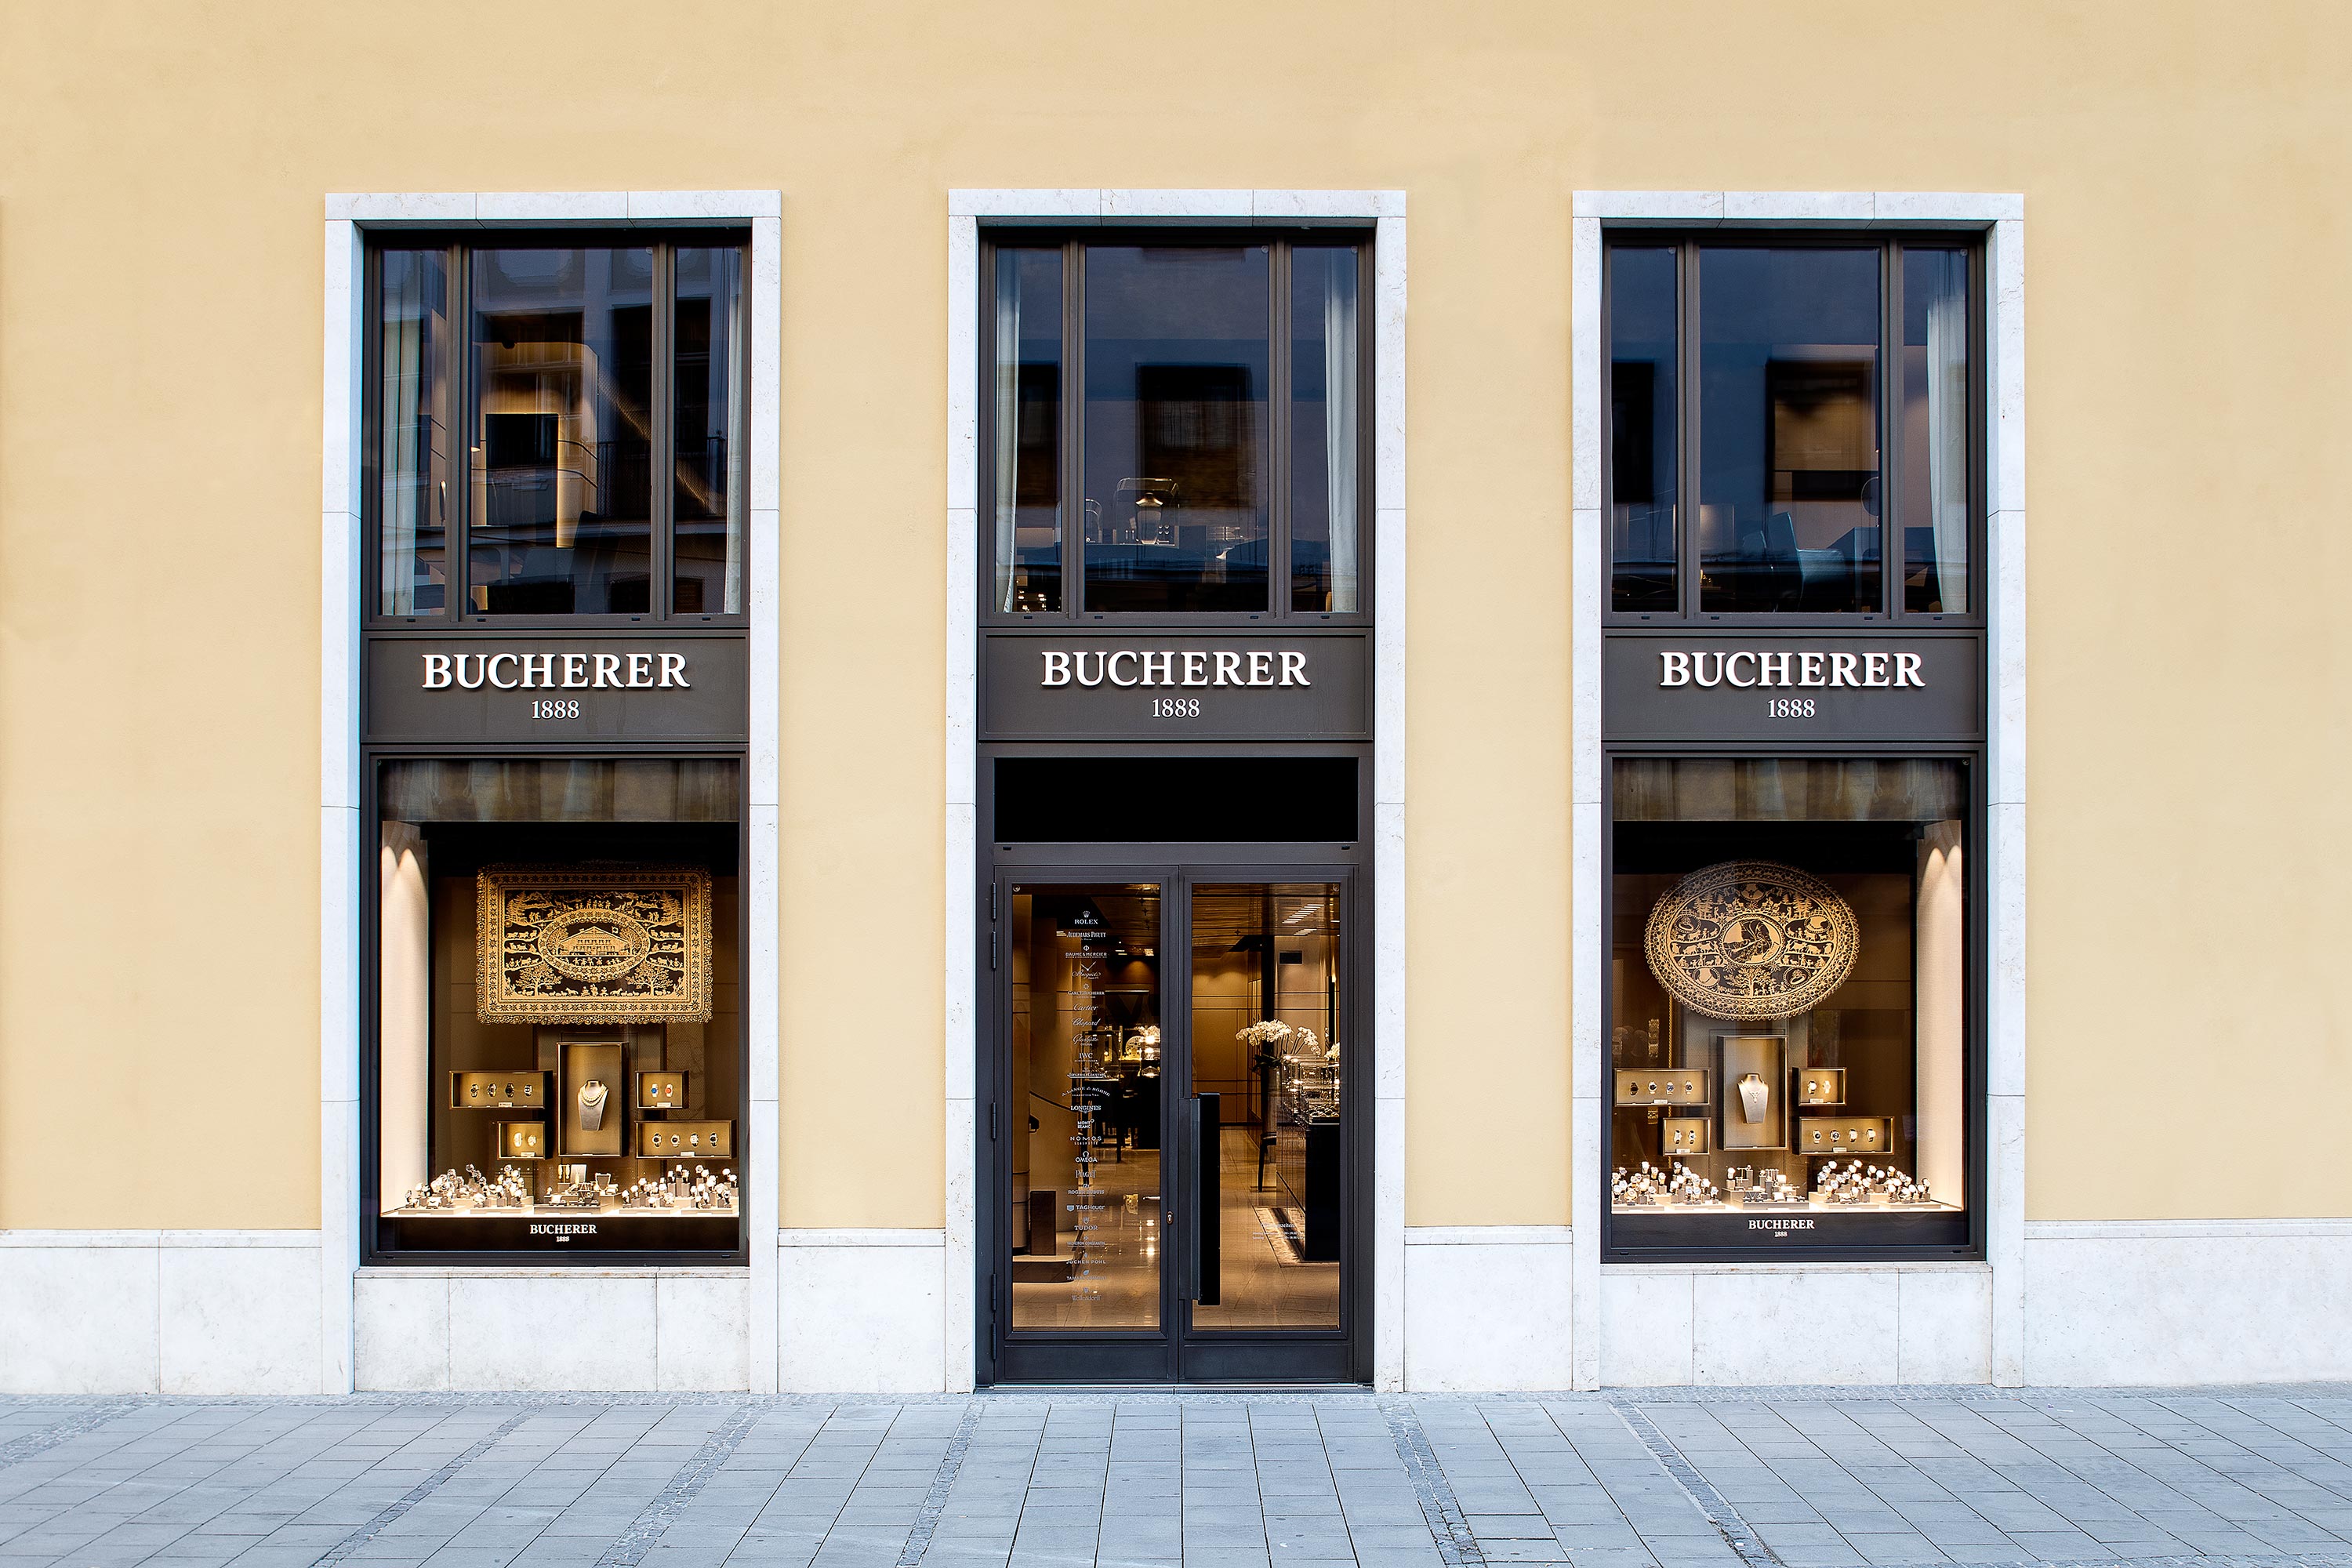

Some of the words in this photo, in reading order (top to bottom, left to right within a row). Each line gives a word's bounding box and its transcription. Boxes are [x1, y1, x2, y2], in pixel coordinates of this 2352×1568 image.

[421, 652, 691, 689] BUCHERER
[1040, 650, 1312, 687] BUCHERER
[1659, 651, 1926, 688] BUCHERER
[531, 700, 580, 720] 1888
[1152, 699, 1200, 718] 1888
[1767, 699, 1816, 718] 1888
[1073, 1003, 1098, 1011] Cartier
[1071, 1018, 1102, 1027] Chopard
[1075, 1170, 1096, 1178] PIAGET
[529, 1224, 597, 1234] BUCHERER
[1748, 1219, 1815, 1229] BUCHERER
